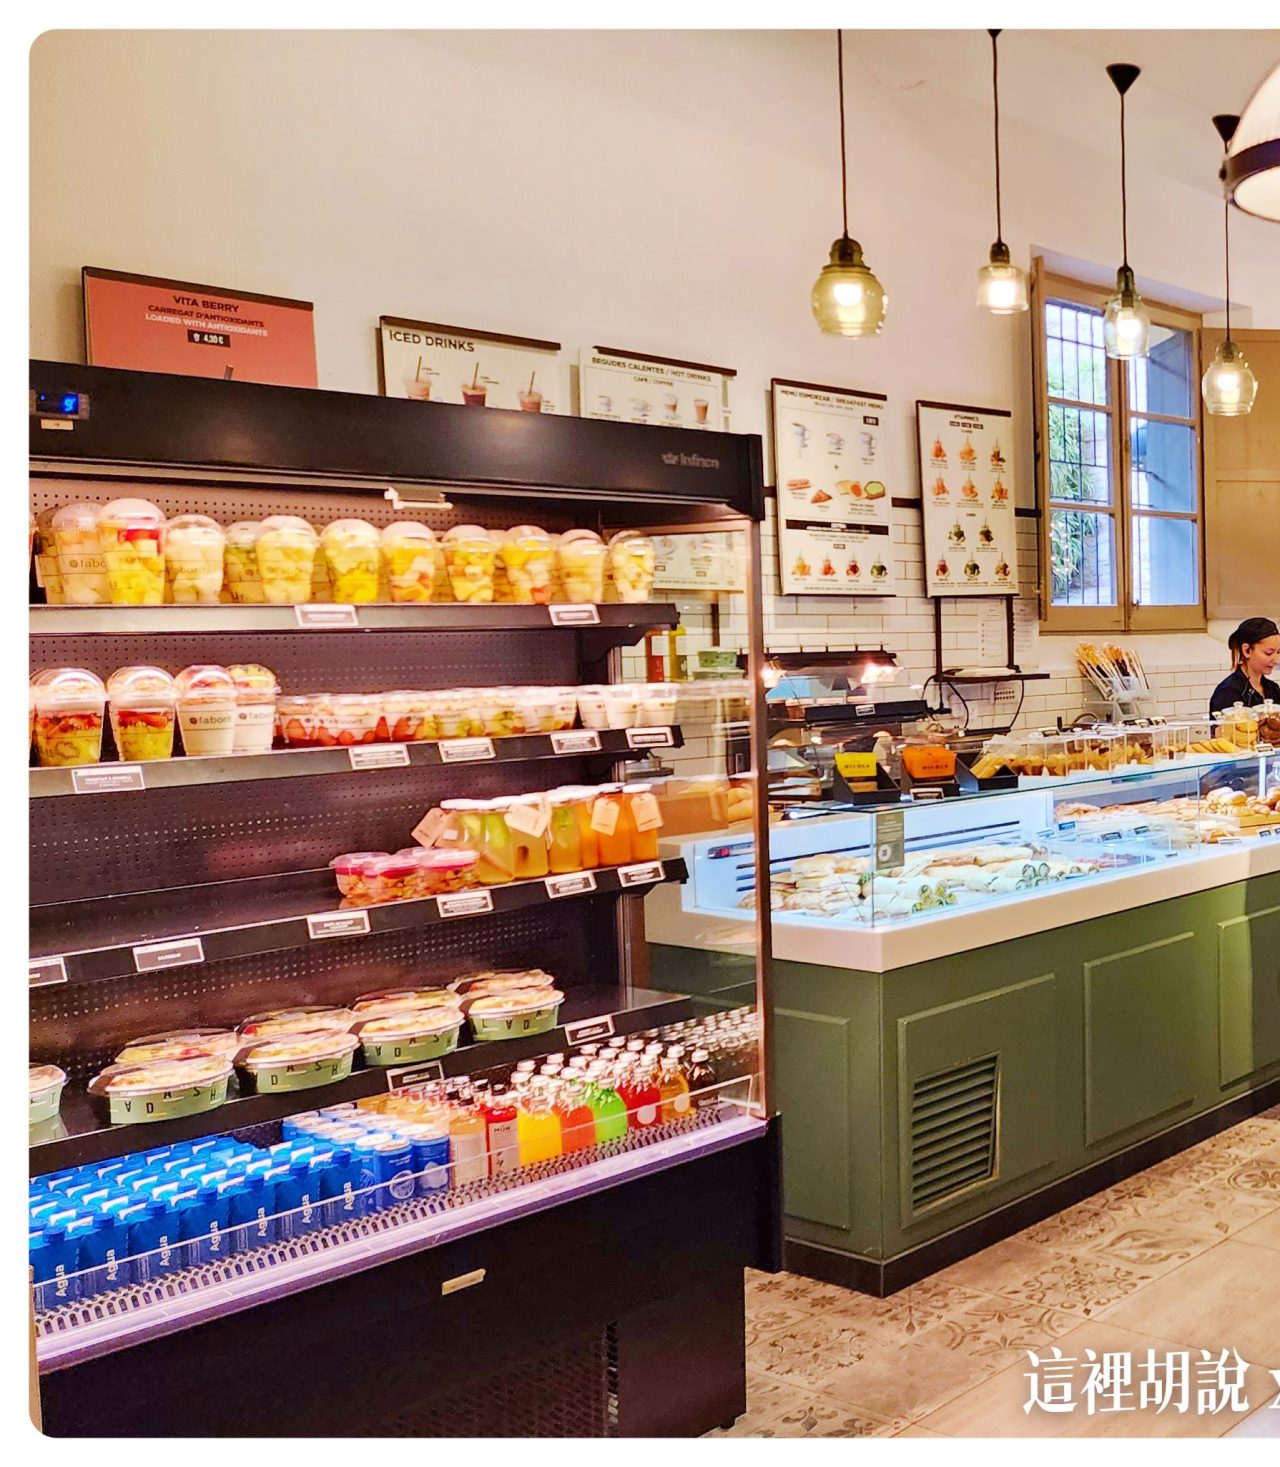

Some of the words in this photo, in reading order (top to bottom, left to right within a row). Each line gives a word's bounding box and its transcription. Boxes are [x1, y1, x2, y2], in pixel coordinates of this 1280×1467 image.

[148, 305, 195, 318] CARREGAT
[173, 295, 199, 307] VITA
[202, 300, 239, 313] BERRY
[145, 313, 182, 325] LOADED
[183, 318, 206, 329] WITH
[206, 321, 268, 337] ANTIOXIDANTS
[389, 330, 421, 344] ICED
[425, 336, 475, 352] DRINKS
[592, 357, 627, 369] BEGUDES
[628, 362, 664, 376] CALENTES
[670, 369, 686, 378] HOT
[686, 371, 712, 382] DRINKS
[302, 1194, 312, 1223] Agua
[344, 1182, 354, 1210] Agua
[210, 1221, 221, 1251] Agua
[258, 1207, 267, 1237] Agua
[159, 1235, 171, 1266] Agua
[107, 1249, 118, 1281] Agua
[56, 1264, 67, 1297] Agua
